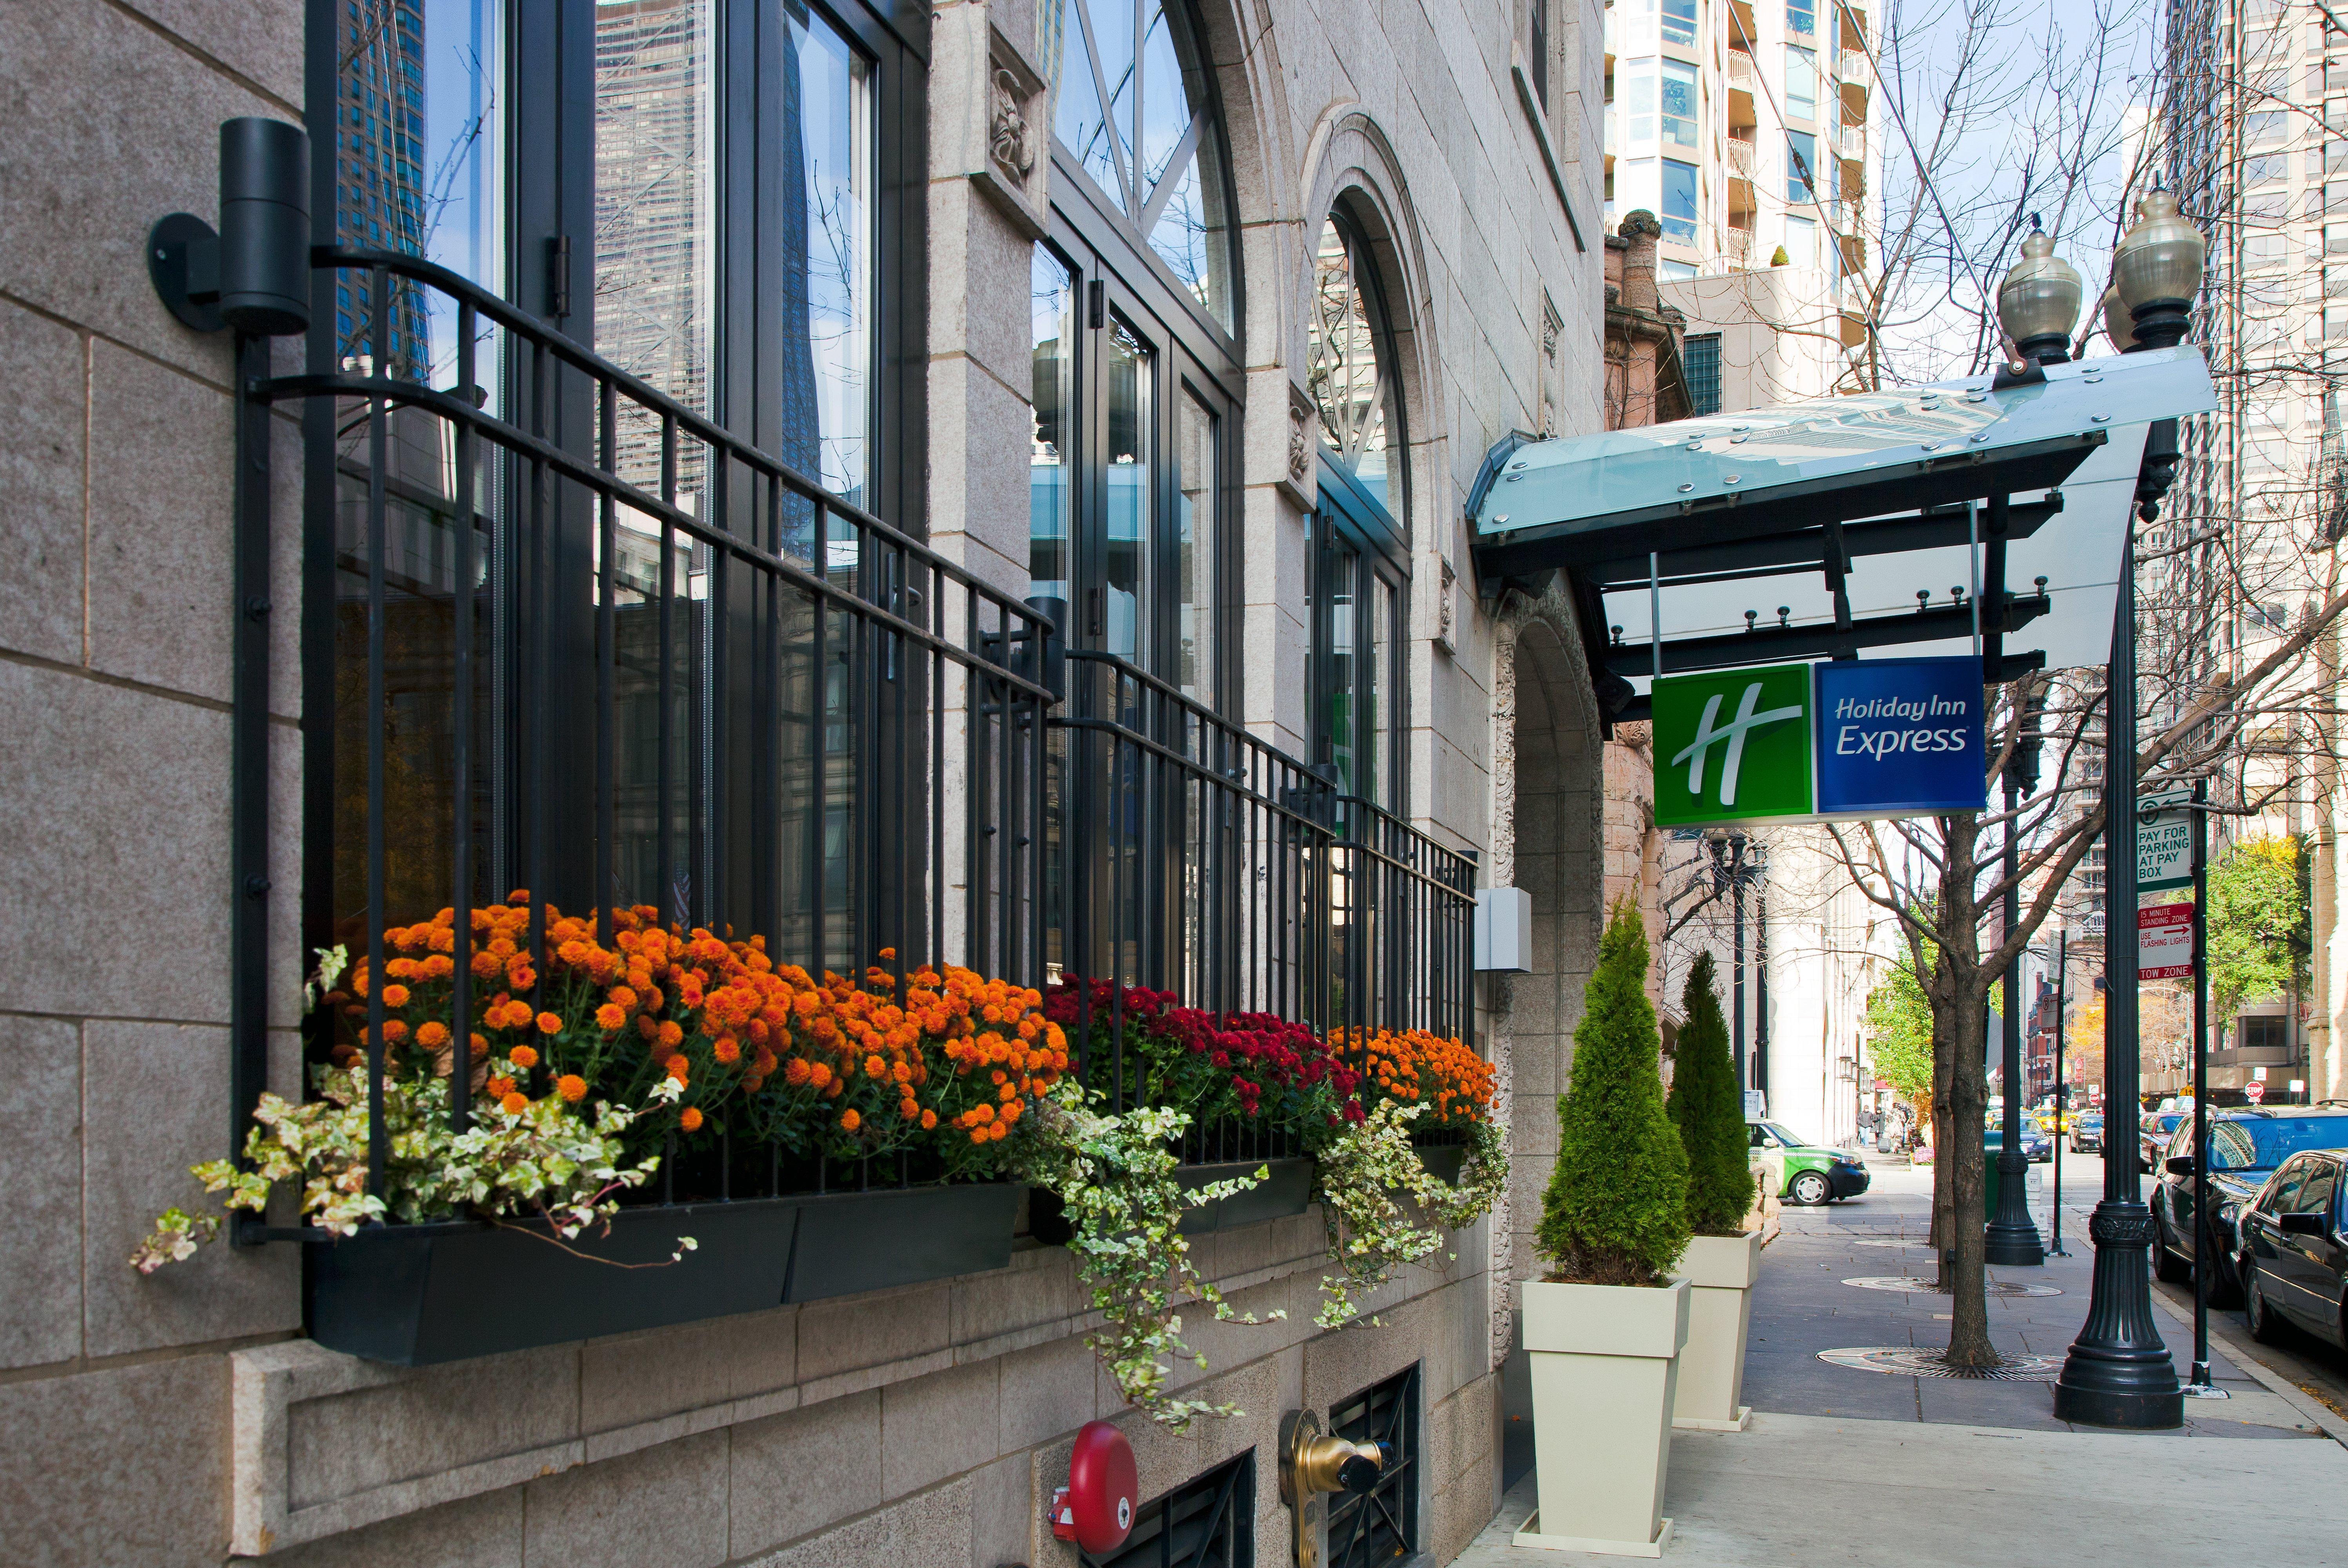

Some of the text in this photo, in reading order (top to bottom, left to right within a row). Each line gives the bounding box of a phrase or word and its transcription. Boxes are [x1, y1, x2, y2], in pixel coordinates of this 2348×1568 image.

[1835, 695, 1966, 721] Holiday Inn
[1836, 725, 1966, 761] Express
[2139, 826, 2186, 843] PAY FOR
[2139, 838, 2189, 855] PARKING
[2139, 851, 2179, 867] AT PAY
[2139, 866, 2162, 879] BOX
[2150, 908, 2171, 917] MINUTE
[2141, 915, 2187, 926] STANDING ZONE
[2141, 936, 2190, 948] FLASHING LIGHTS
[2141, 966, 2188, 978] TOW ZONE
